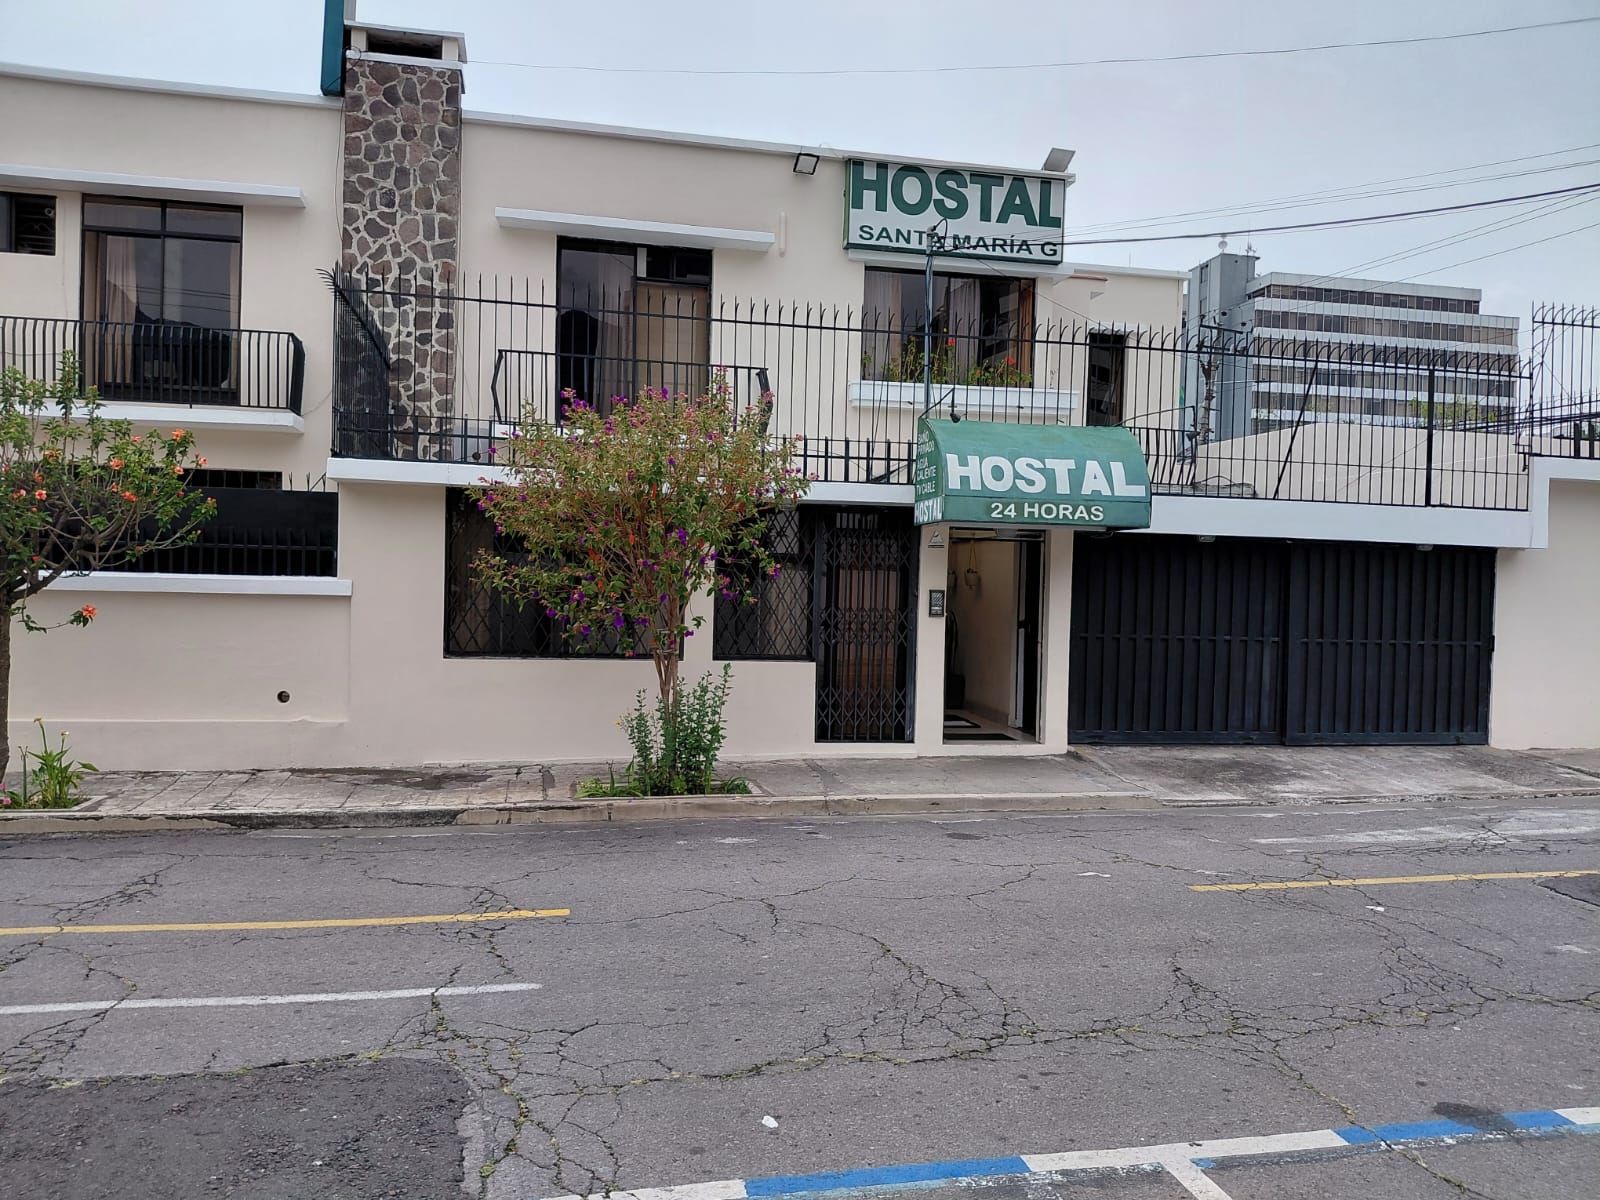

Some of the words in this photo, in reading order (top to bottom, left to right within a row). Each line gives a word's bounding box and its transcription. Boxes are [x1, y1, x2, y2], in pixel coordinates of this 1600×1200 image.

[851, 161, 1062, 228] HOSTAL
[859, 225, 945, 249] SANTA
[952, 234, 1033, 255] MARÍA
[1041, 241, 1058, 256] G
[916, 465, 937, 481] CALIENTE
[946, 453, 1146, 497] HOSTAL
[922, 481, 936, 494] CABLE
[914, 497, 942, 524] HOSTAL
[990, 502, 1017, 518] 24
[1023, 503, 1104, 521] HORAS
